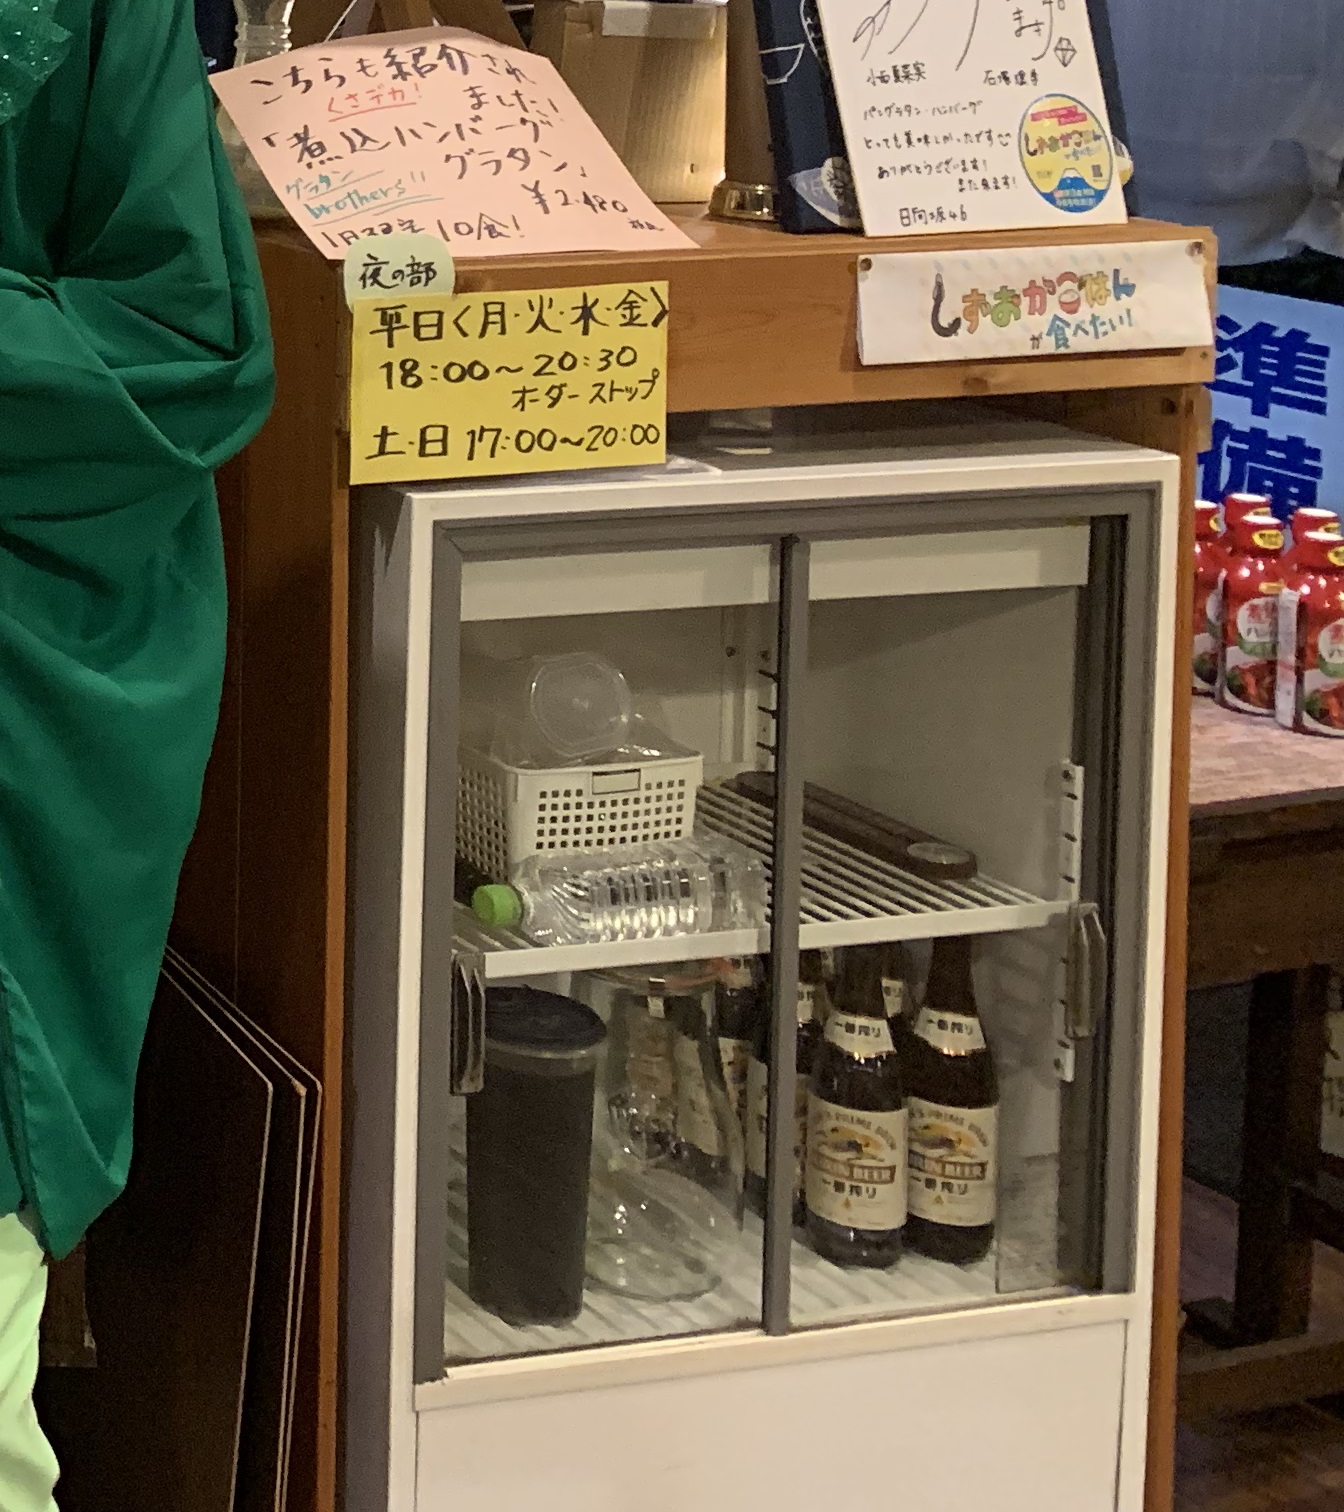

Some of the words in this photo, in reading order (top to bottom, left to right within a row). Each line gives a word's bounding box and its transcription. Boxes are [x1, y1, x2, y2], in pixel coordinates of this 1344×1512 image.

[250, 43, 537, 105] こちらも紹介され
[358, 253, 438, 290] 夜の部
